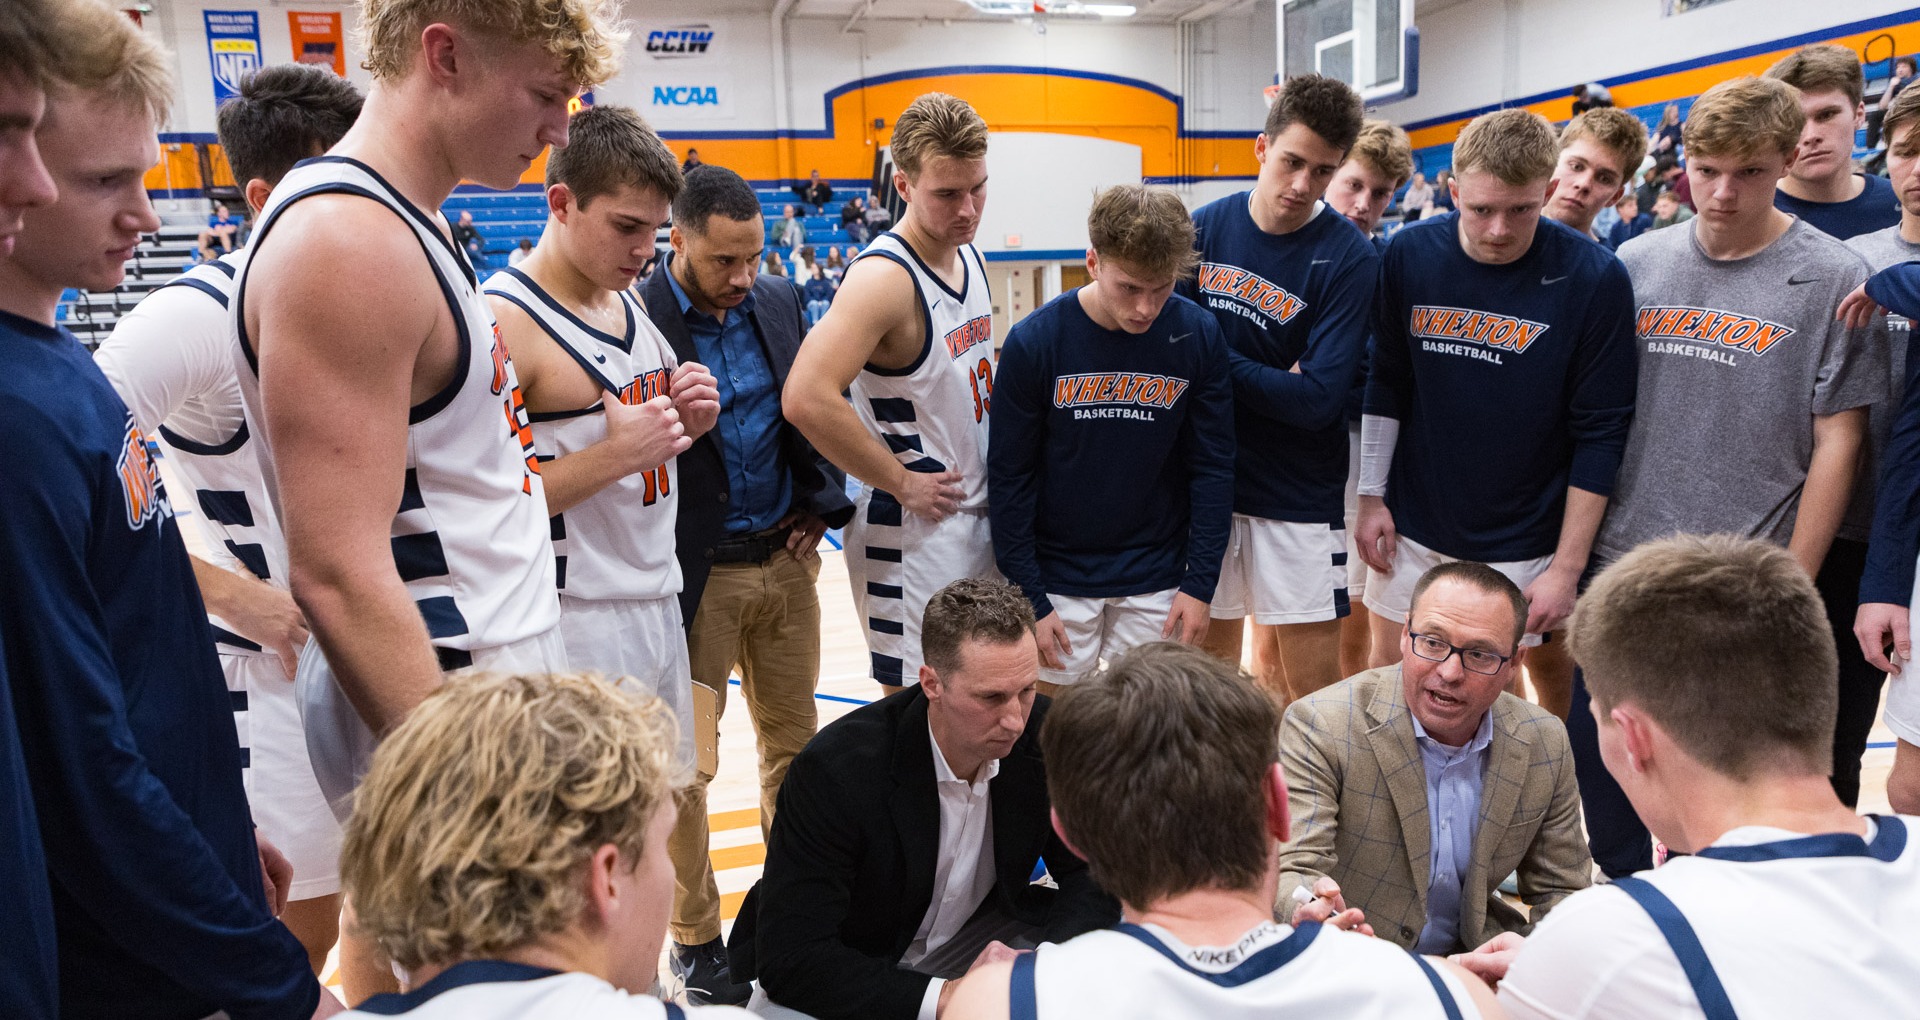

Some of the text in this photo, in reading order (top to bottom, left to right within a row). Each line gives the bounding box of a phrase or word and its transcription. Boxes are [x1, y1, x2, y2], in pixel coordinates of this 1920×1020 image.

[646, 31, 714, 53] CCIW
[653, 86, 718, 105] NCAA
[1198, 262, 1308, 325] WHEATON
[1410, 305, 1550, 354] WHEATON
[1636, 305, 1797, 357] WHEATON
[1422, 340, 1503, 364] BASKETBALL
[1648, 342, 1737, 366] BASKETBALL
[1054, 372, 1189, 409] WHEATON
[1074, 408, 1155, 421] BASKETBALL
